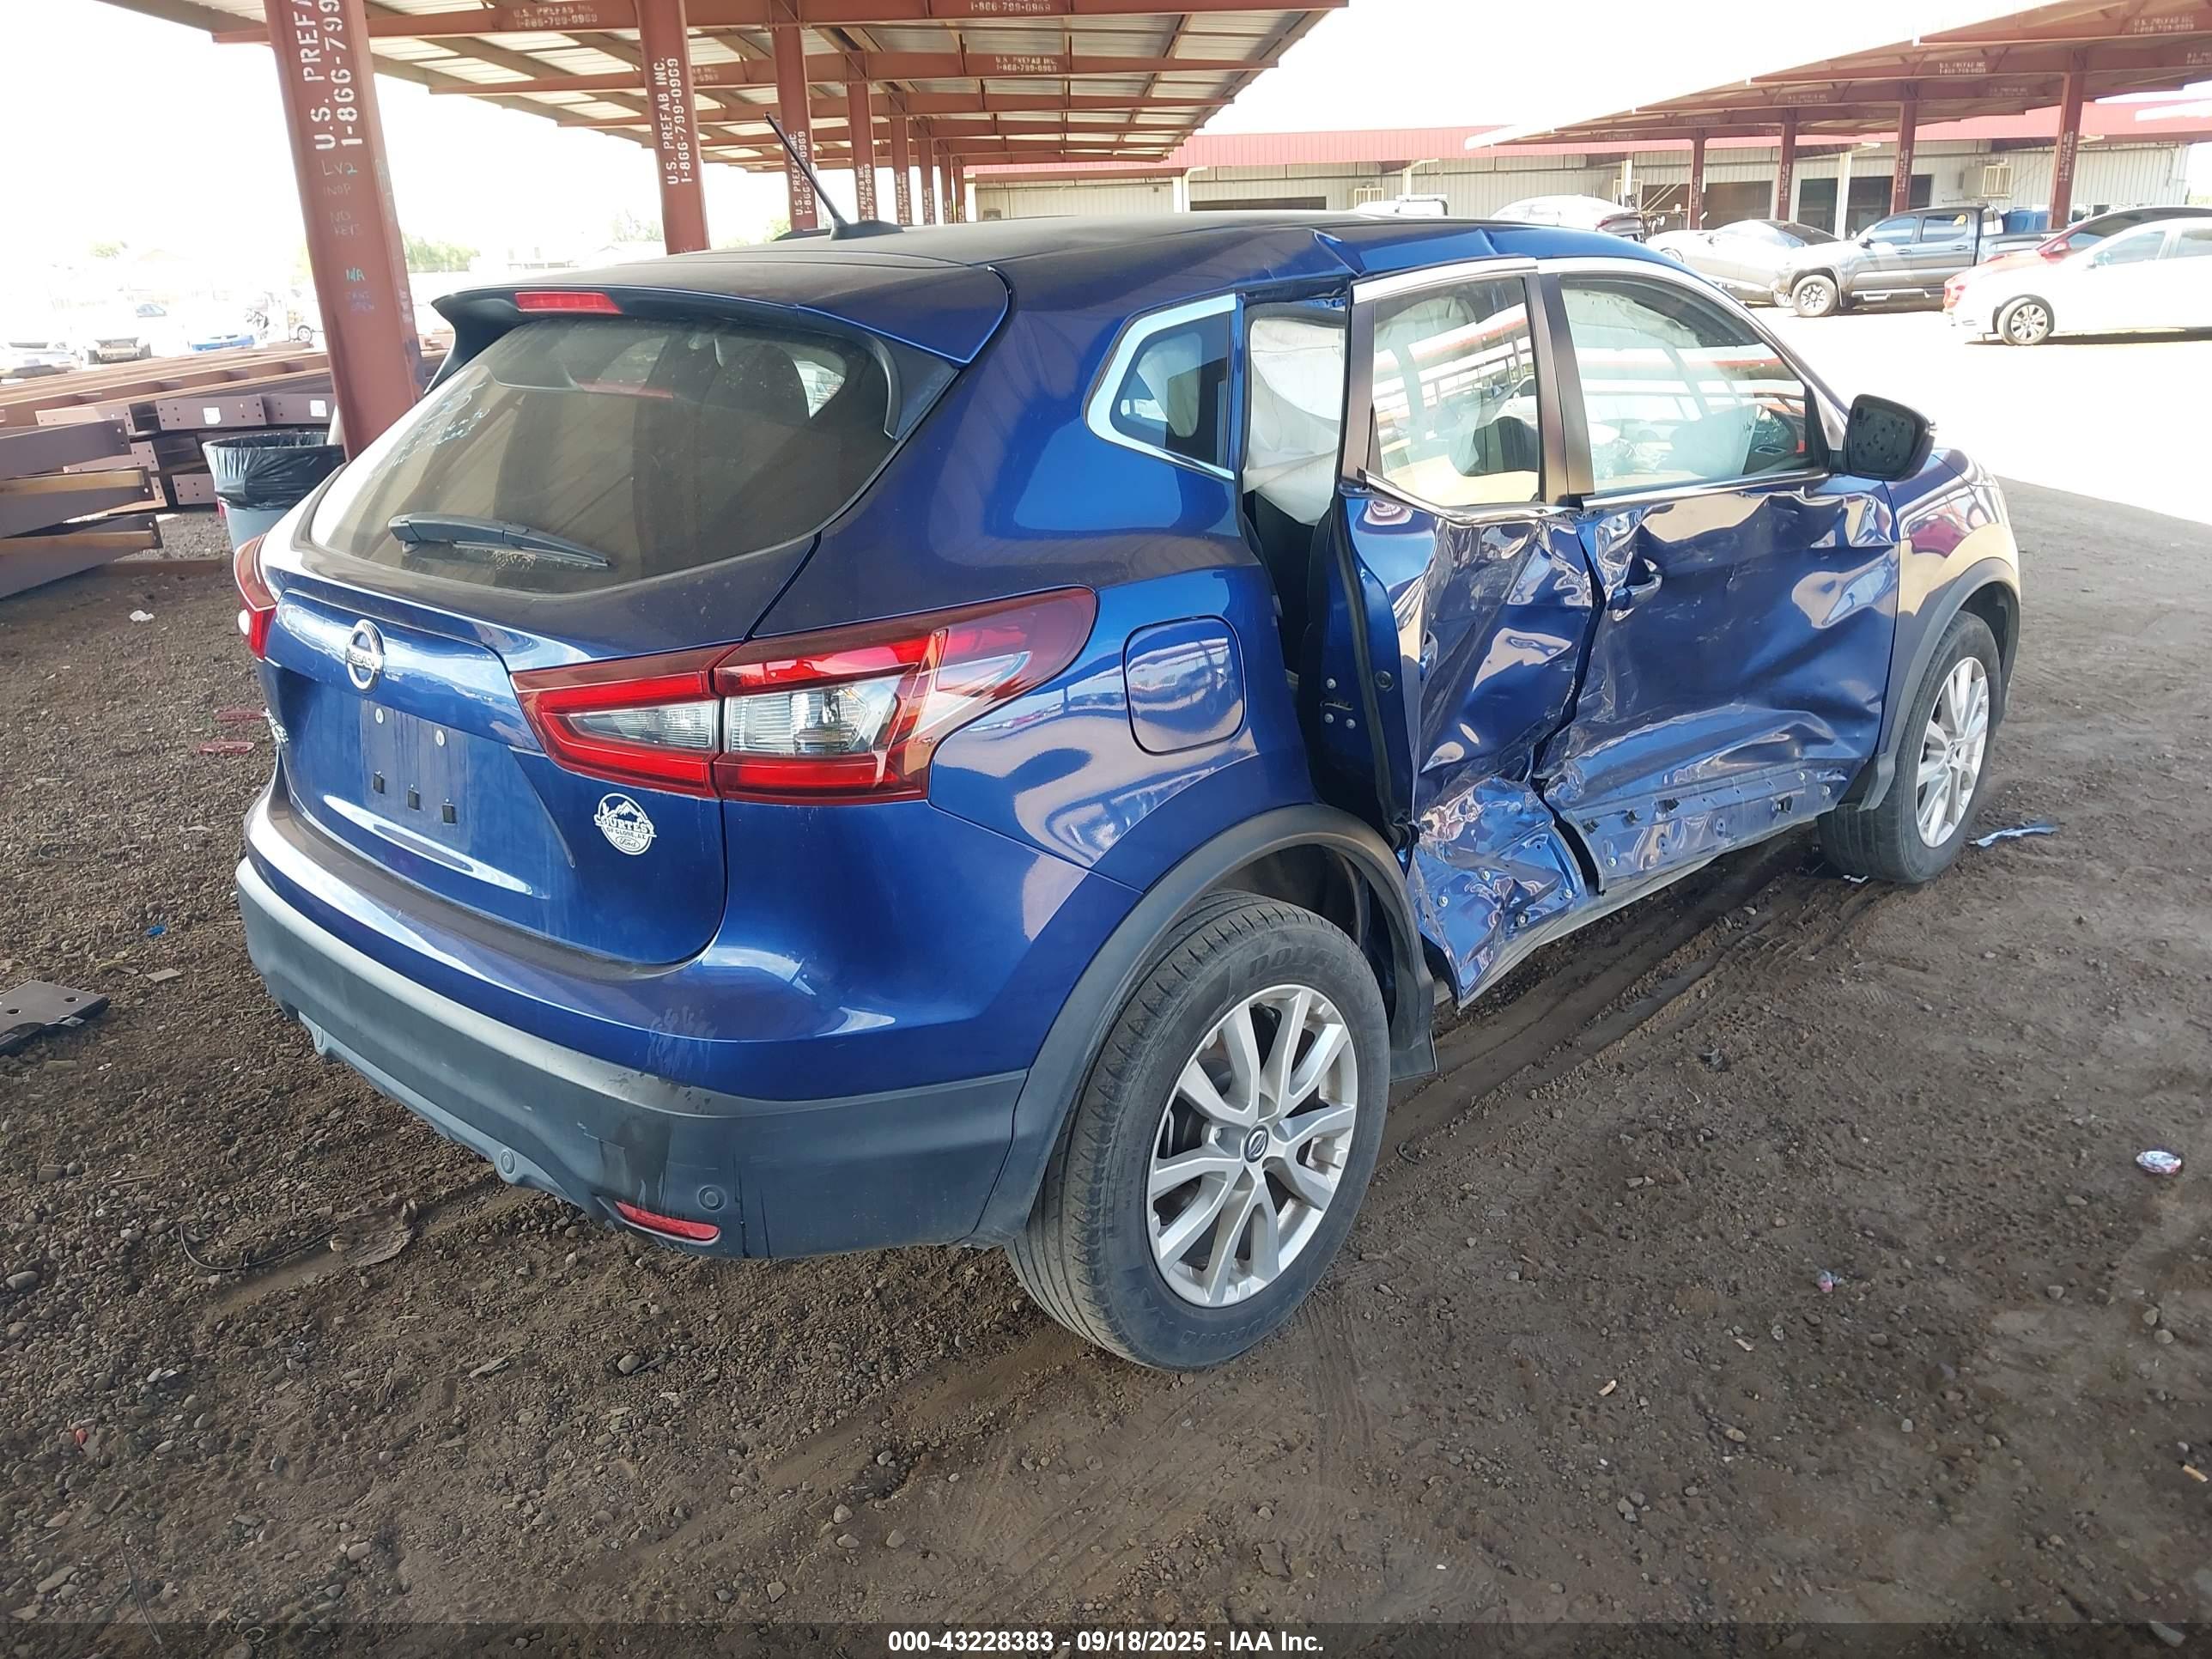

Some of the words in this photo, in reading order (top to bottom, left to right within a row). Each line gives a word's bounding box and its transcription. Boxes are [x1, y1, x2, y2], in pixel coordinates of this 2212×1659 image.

[653, 58, 667, 85] INC.
[310, 99, 336, 149] U.S.
[657, 94, 675, 149] PREFAB
[666, 58, 693, 183] 1-866-799-0969
[788, 131, 798, 149] NC.
[666, 156, 678, 185] U.S.
[798, 131, 813, 214] 1-866-7-0969
[794, 197, 804, 216] U.S.
[593, 813, 655, 836] COURTESY
